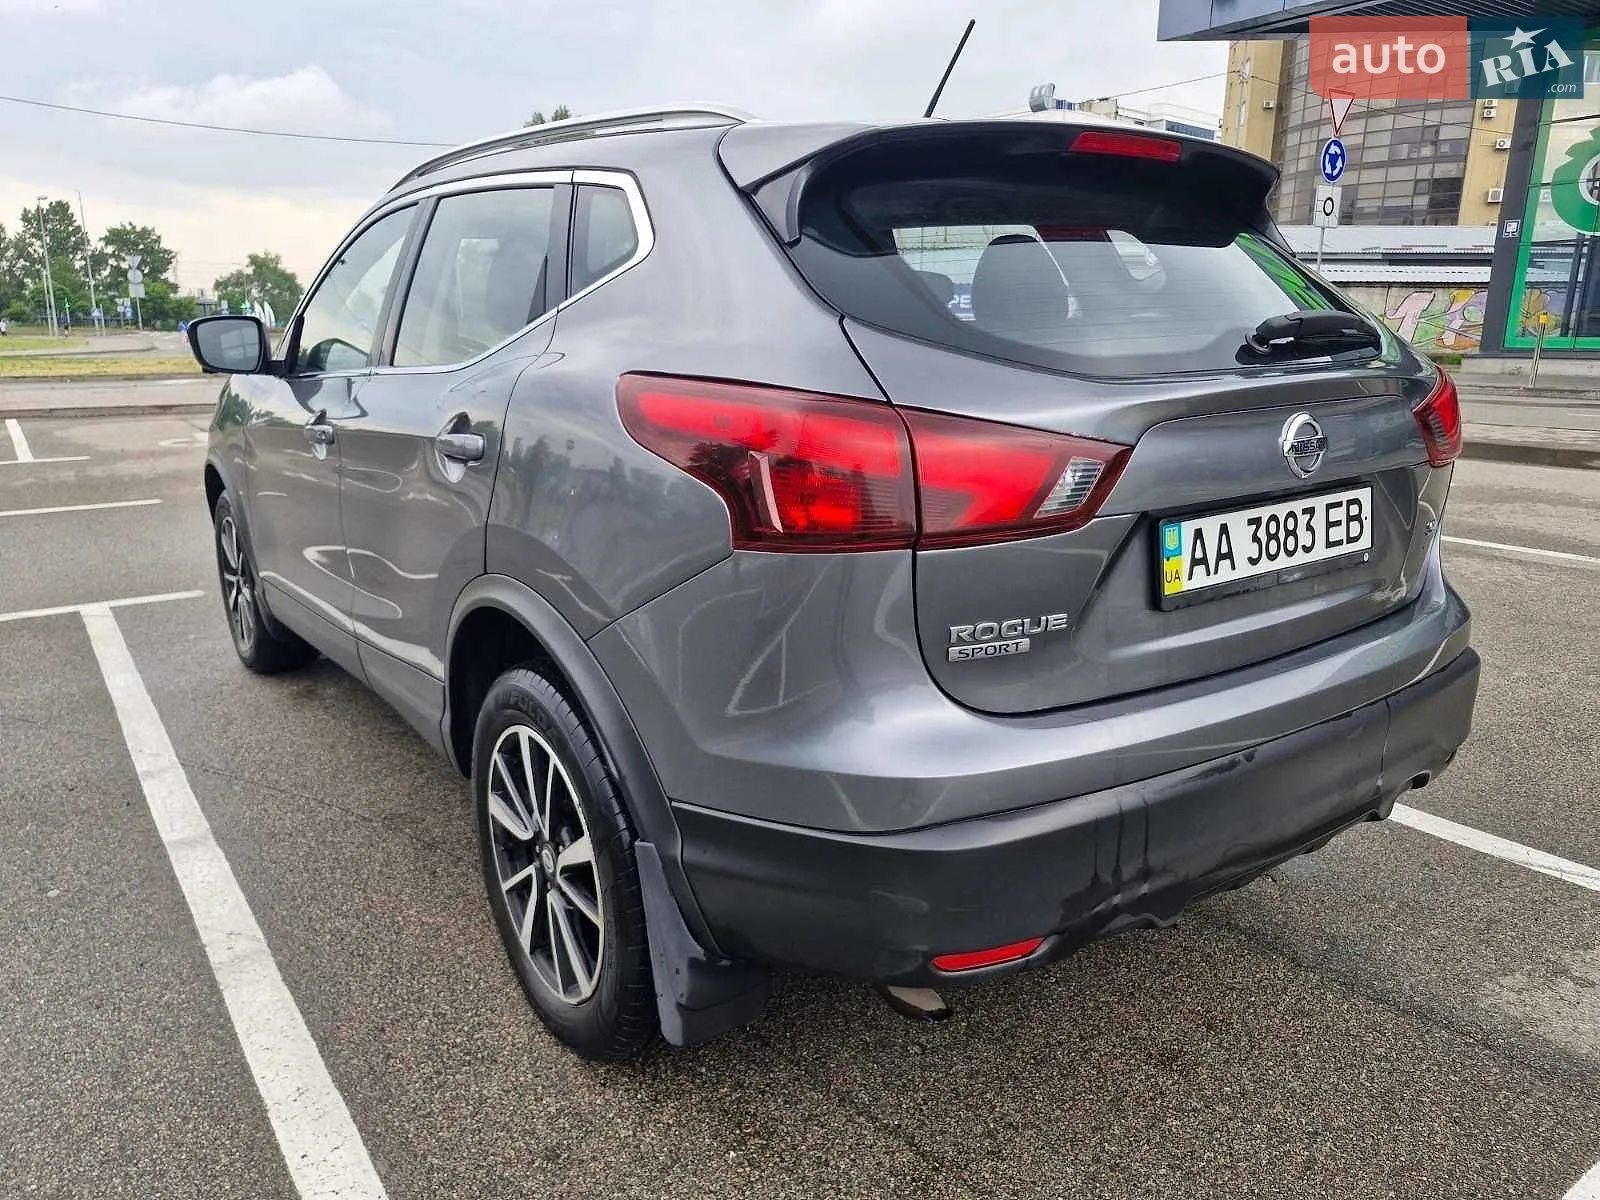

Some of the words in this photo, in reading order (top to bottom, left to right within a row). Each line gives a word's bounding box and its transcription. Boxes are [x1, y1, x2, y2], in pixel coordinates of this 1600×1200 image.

[1187, 522, 1236, 581] AA
[1246, 506, 1316, 566] 3883
[1325, 497, 1364, 550] EB
[1165, 569, 1181, 584] UA
[949, 613, 1068, 643] ROGUE
[958, 641, 1023, 659] SPORT
